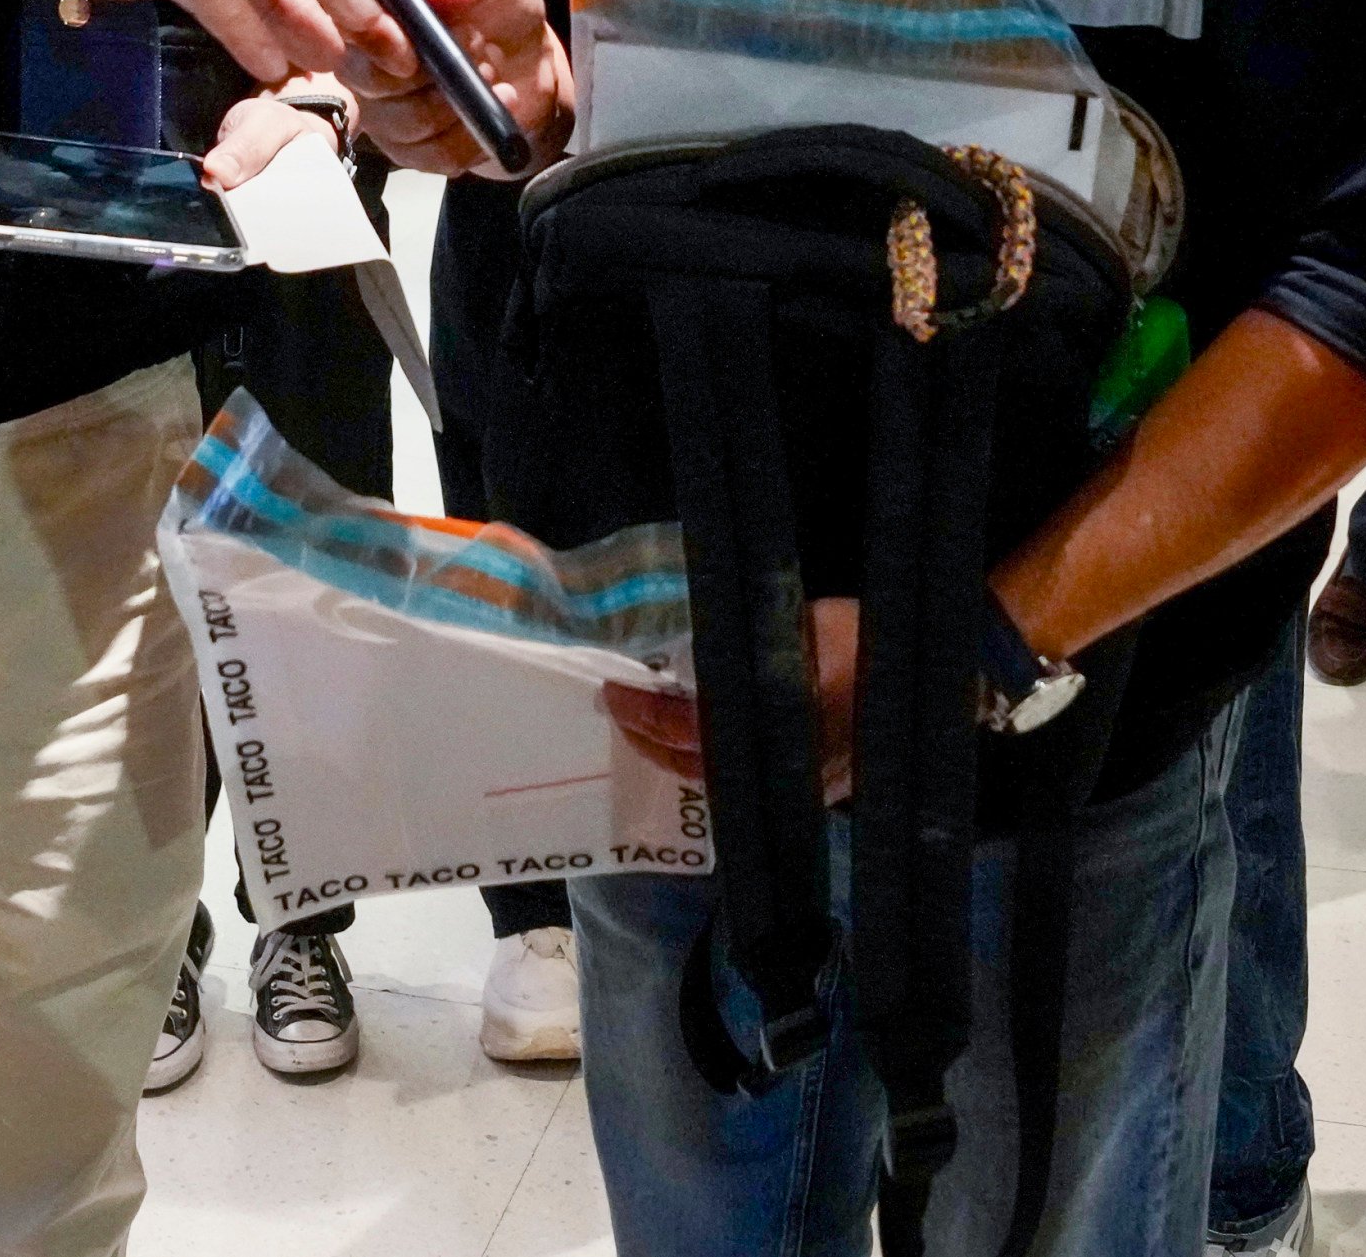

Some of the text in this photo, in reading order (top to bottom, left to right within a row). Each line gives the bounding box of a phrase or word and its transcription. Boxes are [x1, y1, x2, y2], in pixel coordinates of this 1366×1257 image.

[198, 589, 238, 645] TACO
[217, 658, 257, 727] TACO
[236, 739, 276, 806] TACO
[678, 784, 707, 840] ACO
[254, 817, 291, 885] TACO
[274, 845, 706, 913] TACO TACO TACO TACO
